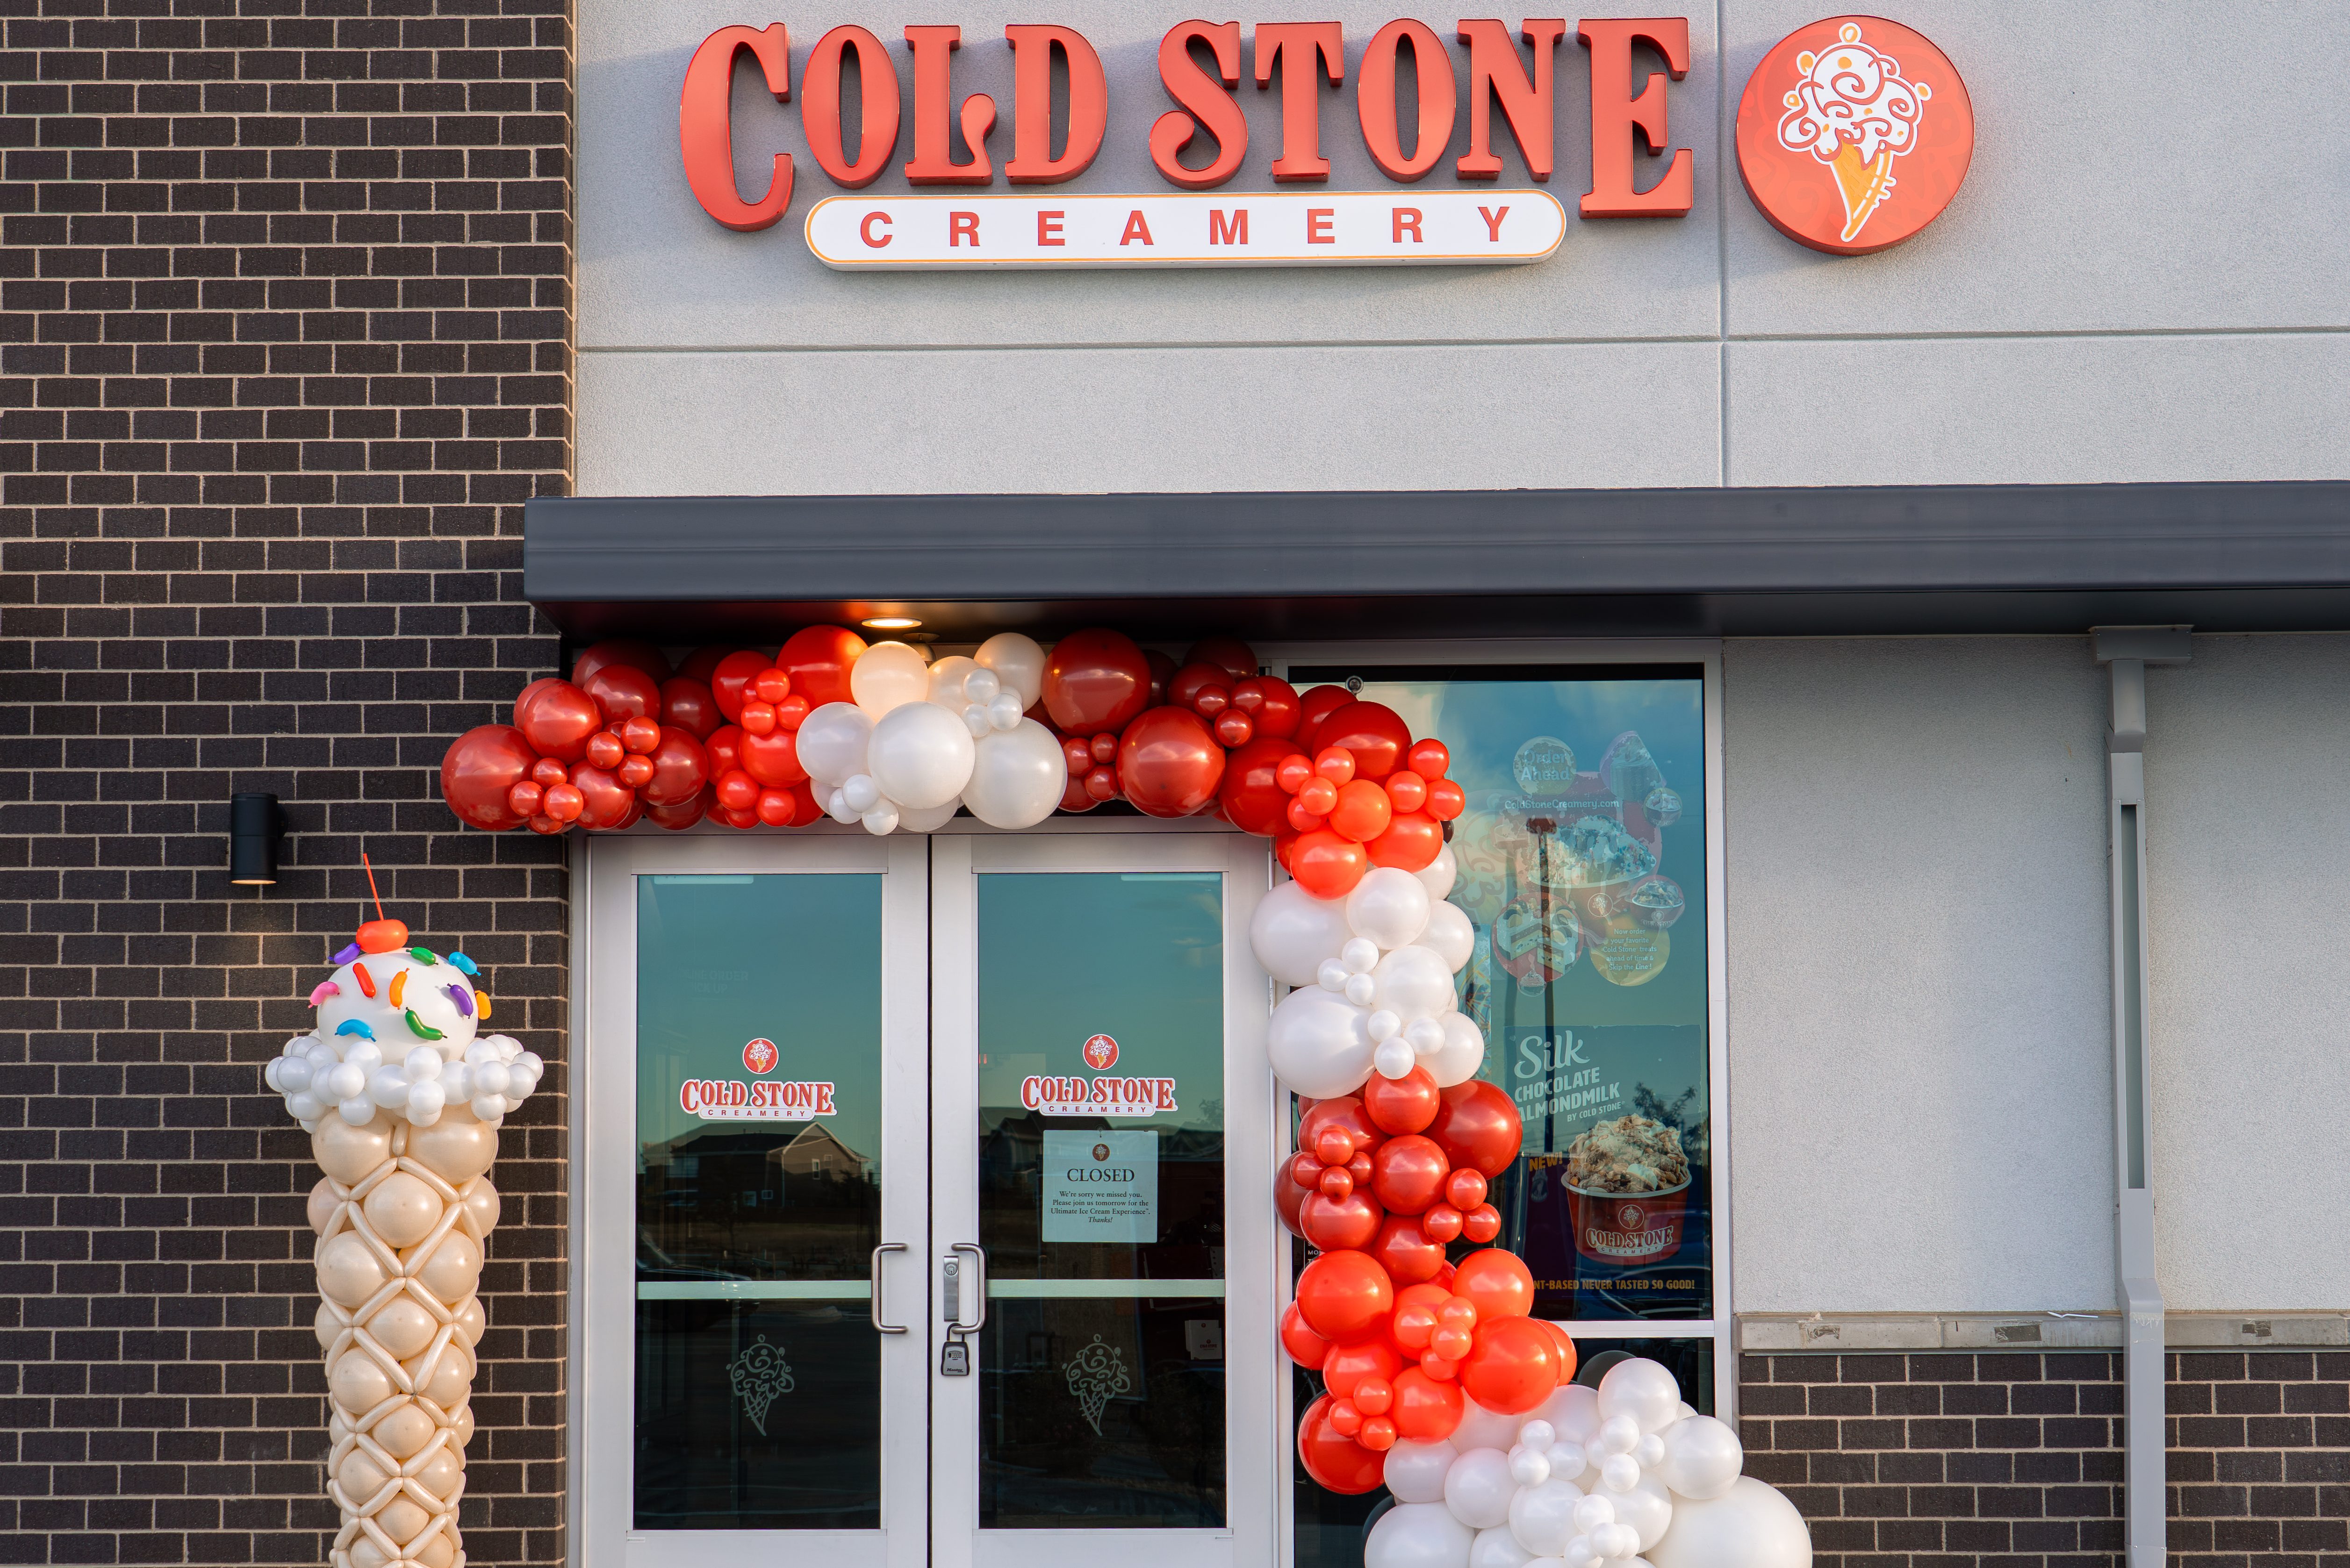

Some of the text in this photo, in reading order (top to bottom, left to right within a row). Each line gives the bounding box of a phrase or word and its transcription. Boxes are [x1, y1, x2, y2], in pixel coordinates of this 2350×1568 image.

[680, 17, 1694, 232] COLD STONE
[860, 206, 1510, 248] CREAMERY
[1524, 749, 1565, 763] Order
[1521, 766, 1570, 780] Ahead
[1504, 799, 1620, 809] ColdStoneCreamery.com
[1514, 1030, 1590, 1079] Silk
[1022, 1077, 1175, 1110] COLD STONE
[1514, 1067, 1600, 1103] CHOCOLATE
[682, 1081, 834, 1114] COLD STONE
[1517, 1081, 1620, 1122] ALMONDMILK
[1567, 1113, 1577, 1122] BY
[1579, 1108, 1597, 1118] COLD
[1529, 1151, 1563, 1172] NEW!
[1067, 1168, 1135, 1182] CLOSED
[1587, 1226, 1673, 1248] COLD STONE
[1601, 1246, 1658, 1254] CREAMERY
[1534, 1280, 1695, 1289] NT-BASED NEVER TASTED SO GOOD!
